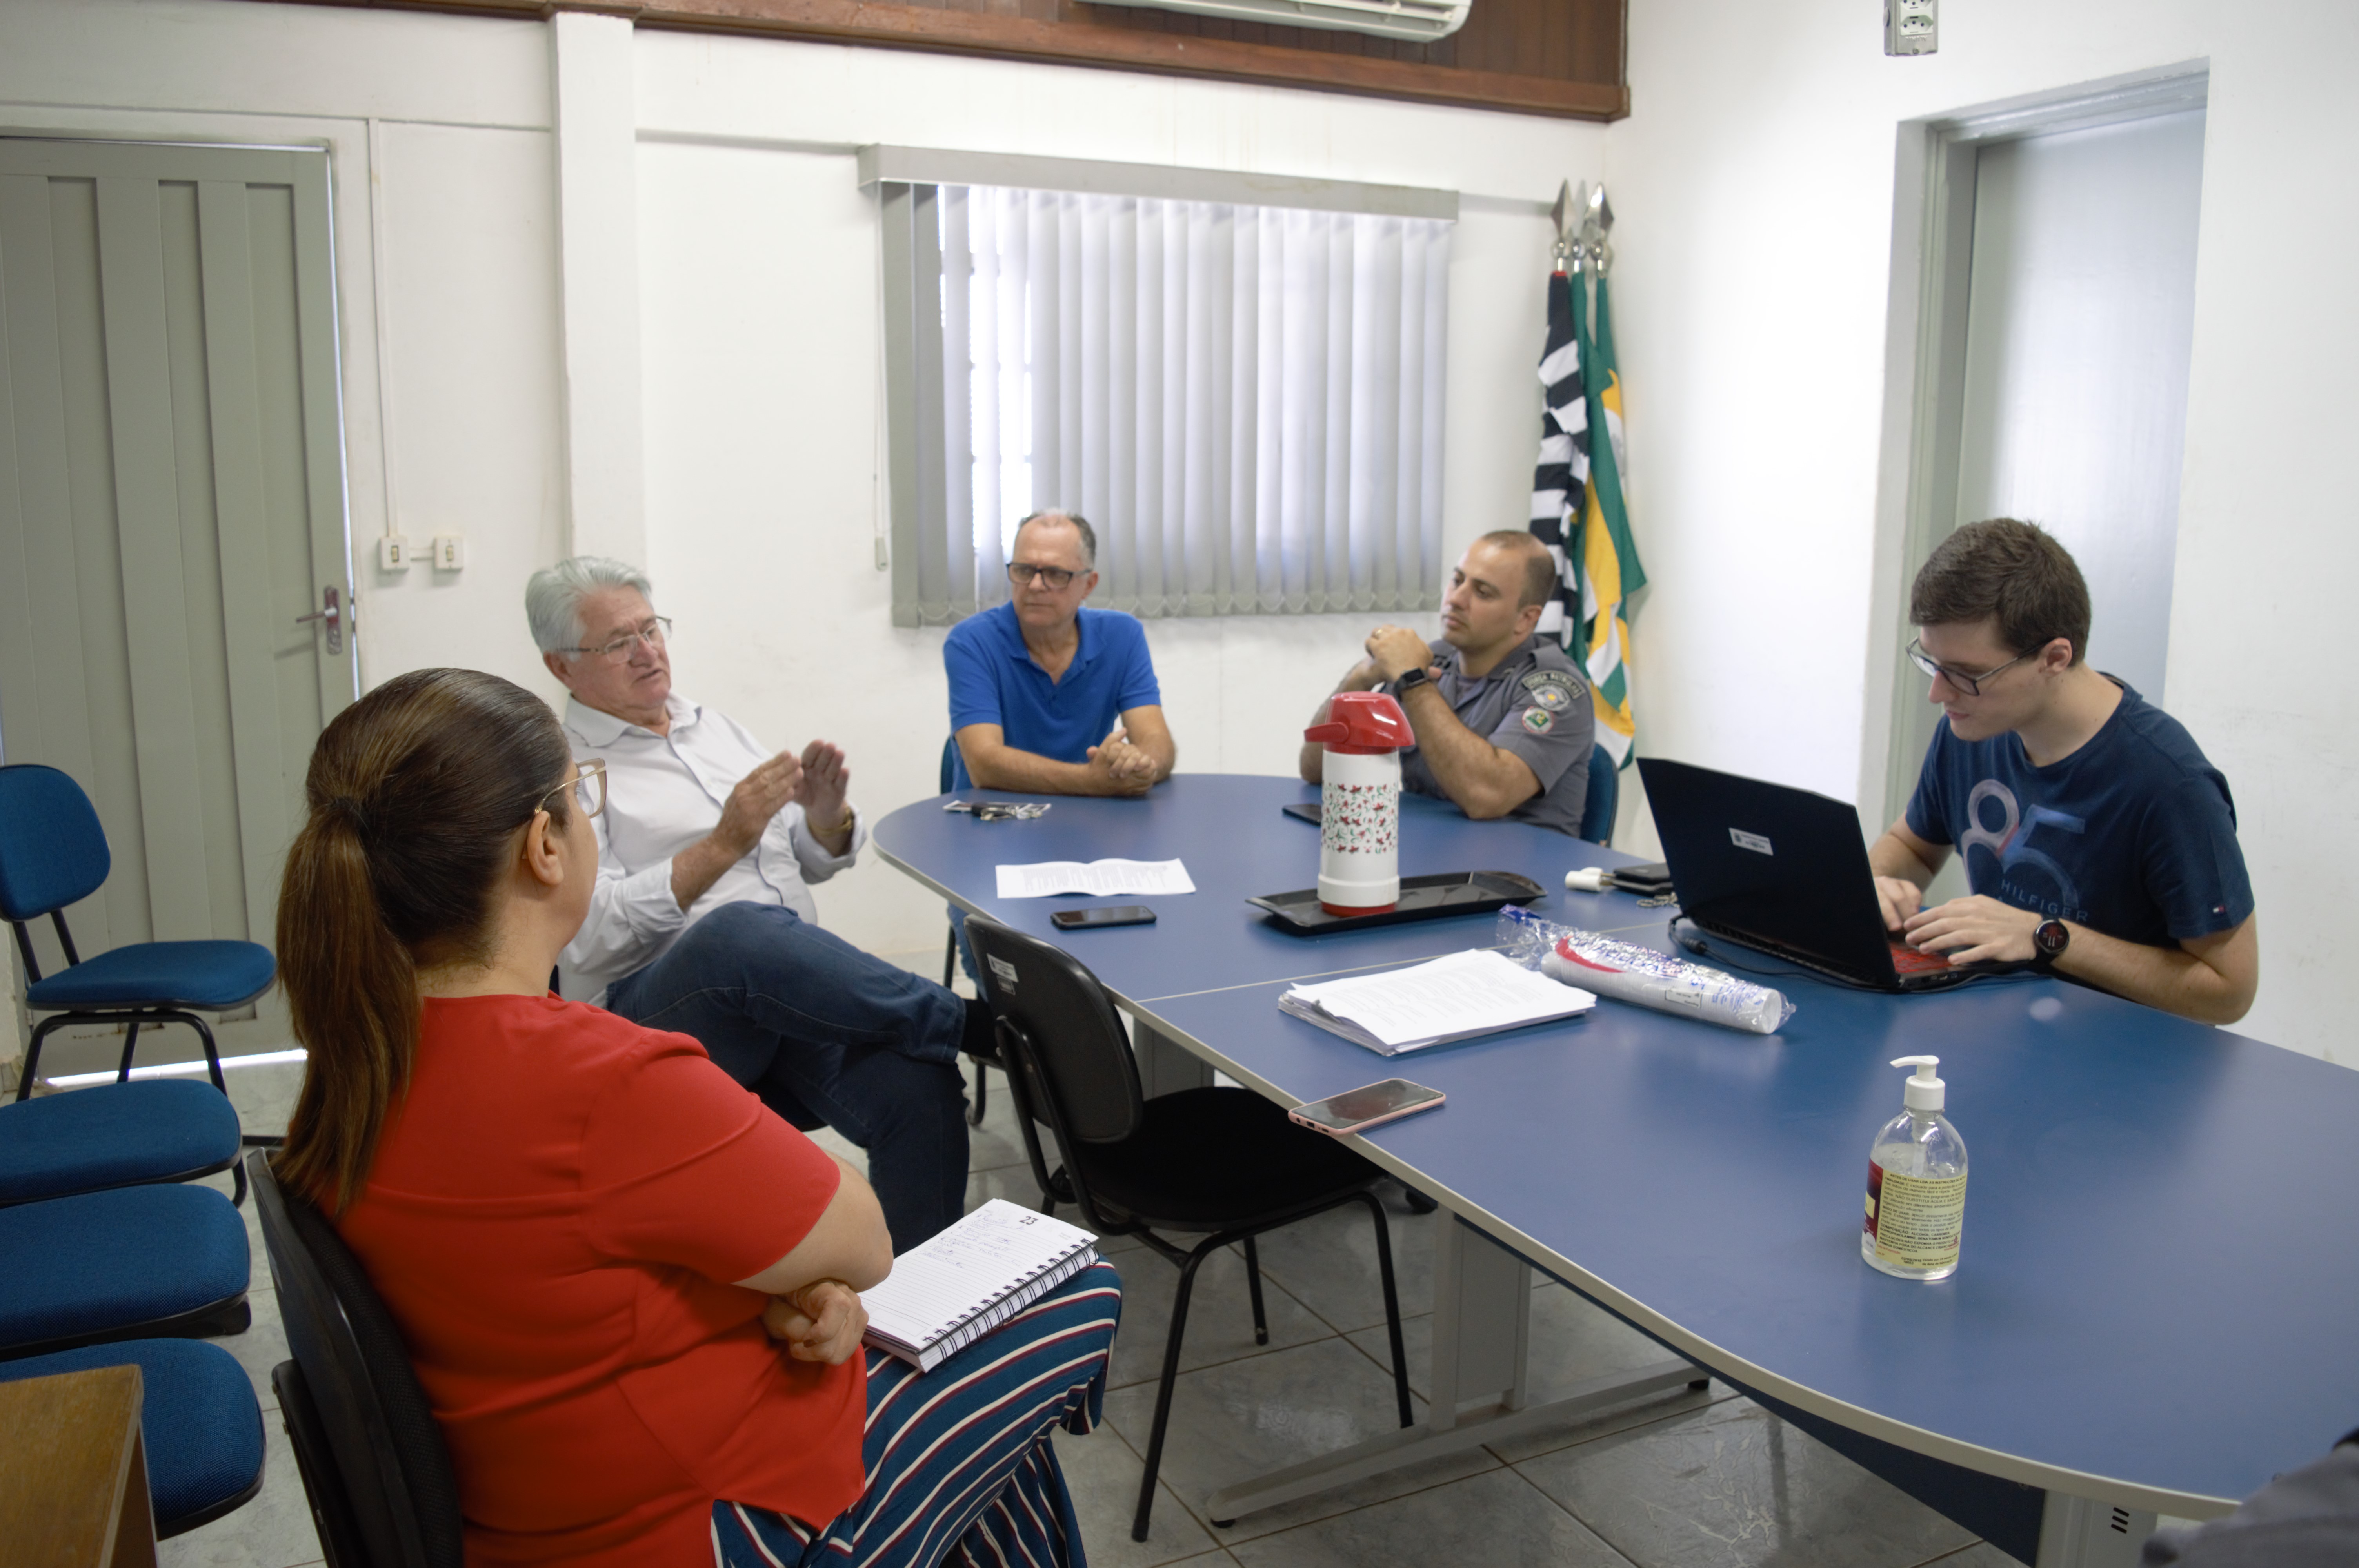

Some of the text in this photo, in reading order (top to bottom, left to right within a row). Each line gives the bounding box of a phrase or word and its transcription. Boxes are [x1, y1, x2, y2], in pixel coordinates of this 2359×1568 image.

[2001, 879, 2088, 922] HILFIGER
[1019, 1216, 1039, 1225] 23
[1880, 1236, 1898, 1245] MANTENHA
